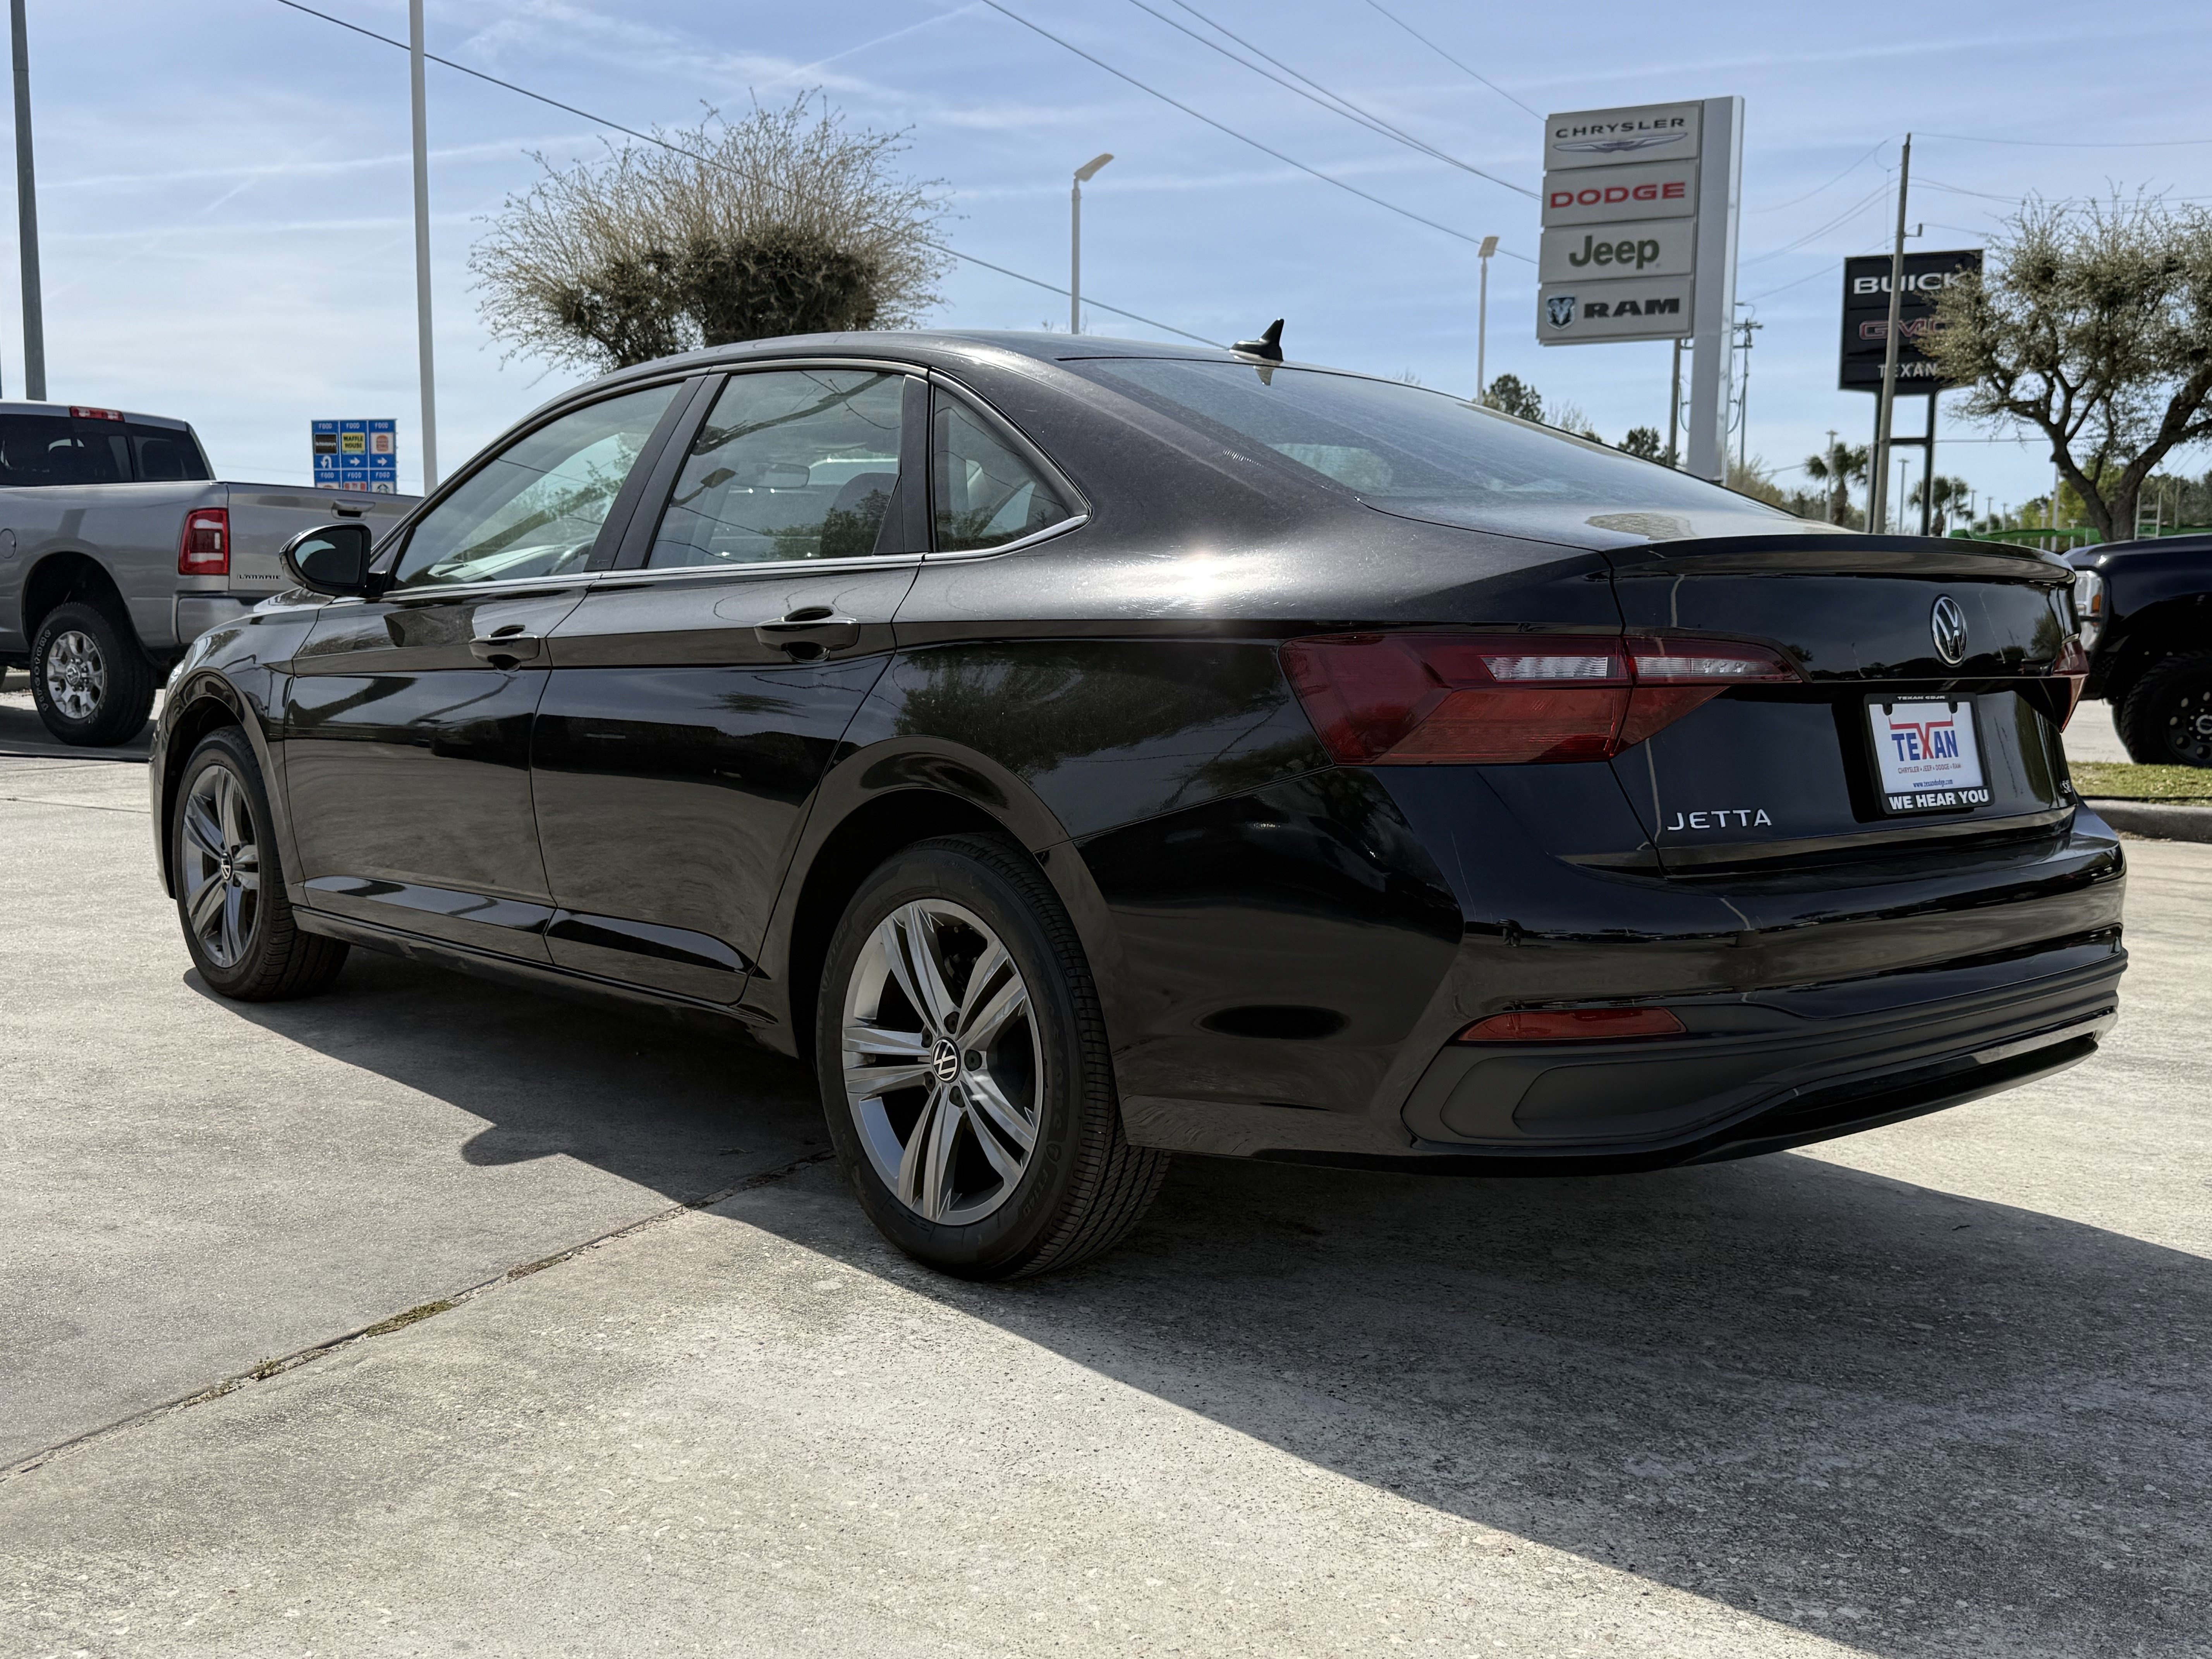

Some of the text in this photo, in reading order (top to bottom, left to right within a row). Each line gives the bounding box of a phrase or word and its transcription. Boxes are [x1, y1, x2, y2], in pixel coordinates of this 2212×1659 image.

[1556, 118, 1685, 138] CHRYSLER
[1550, 182, 1685, 208] DODGE
[1569, 235, 1659, 269] Jeep
[1854, 272, 1968, 294] BUICK
[1583, 298, 1680, 319] RAM
[1877, 361, 1937, 378] TXAN
[1889, 722, 1959, 762] TEXAN
[1889, 789, 1989, 810] WE HEAR YOU
[1667, 809, 1772, 831] JETTA
